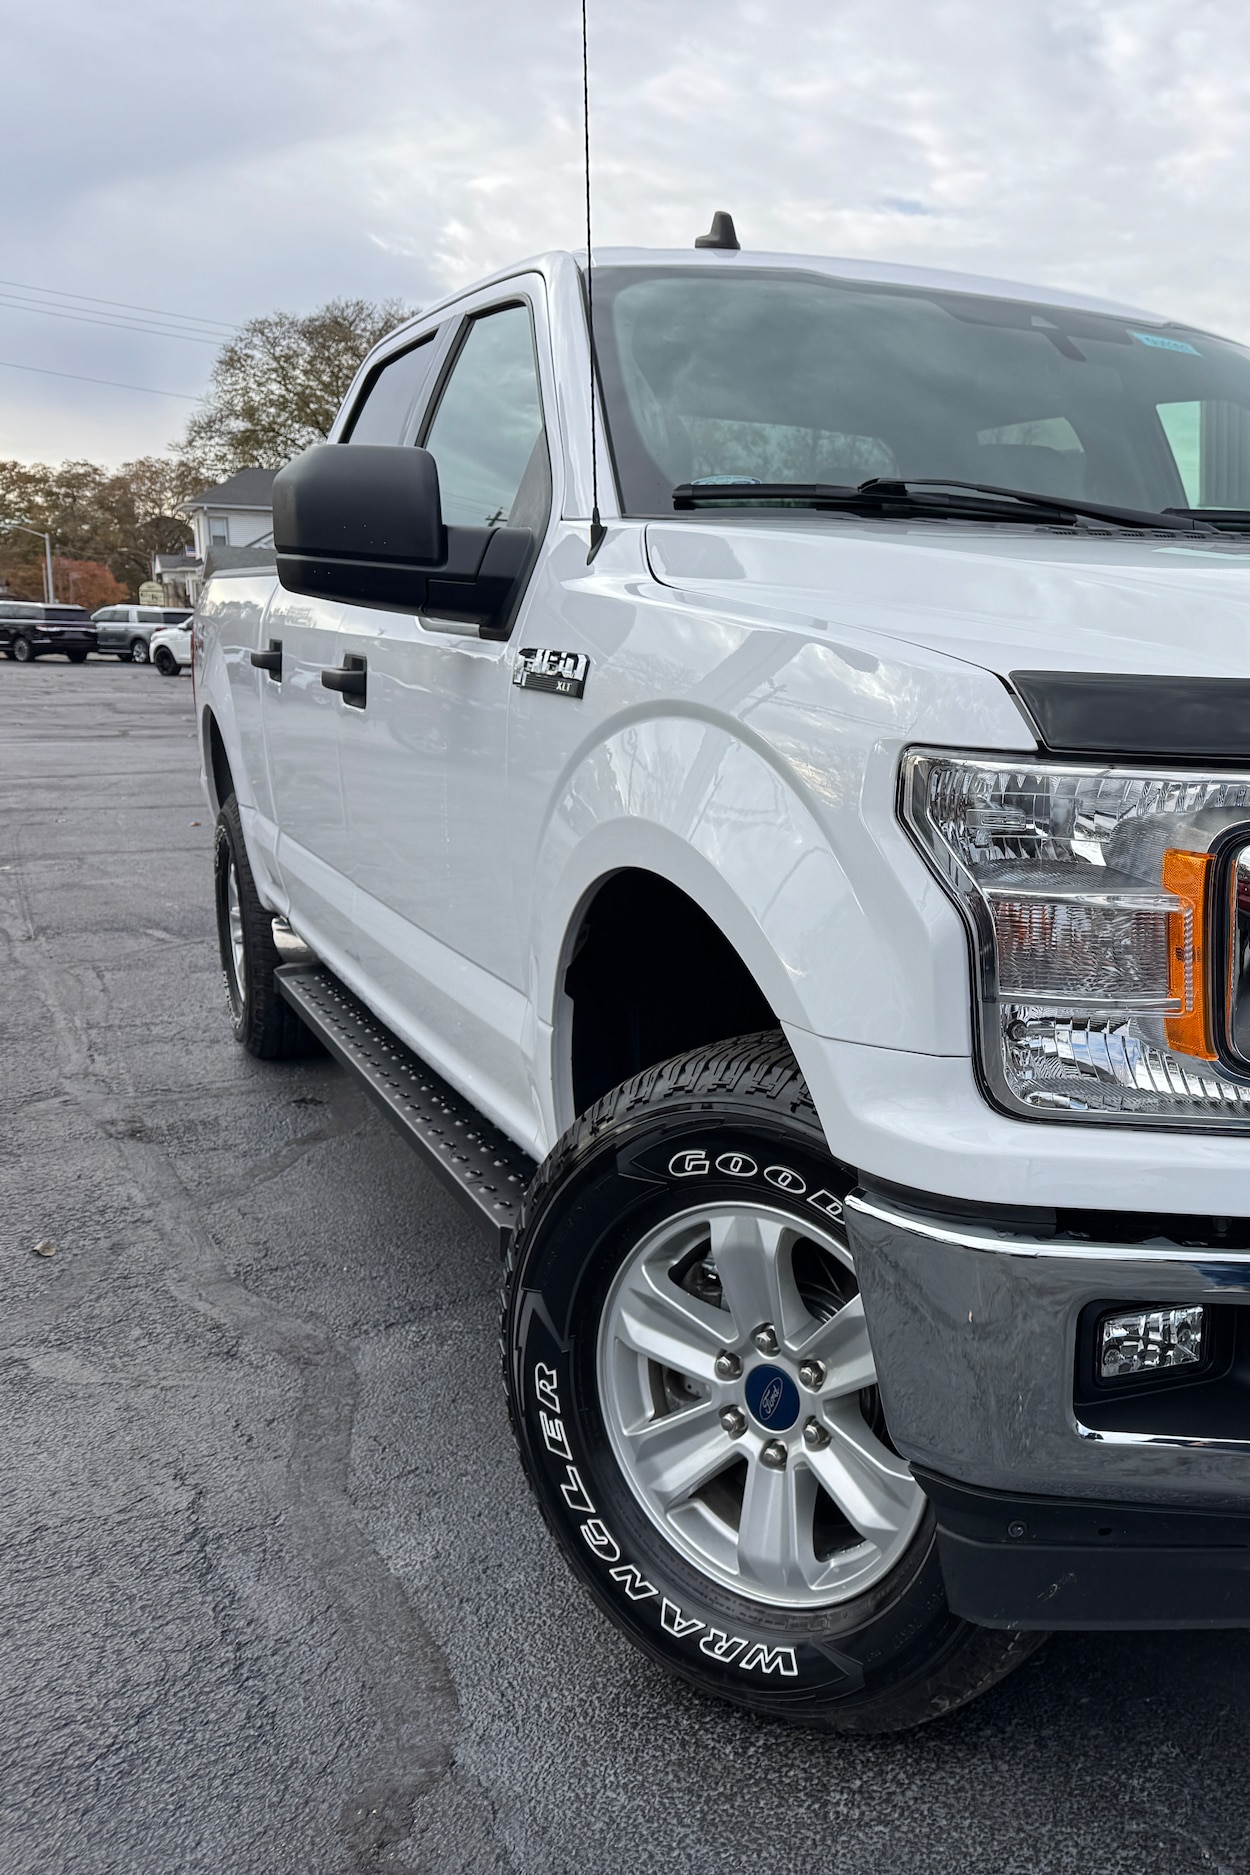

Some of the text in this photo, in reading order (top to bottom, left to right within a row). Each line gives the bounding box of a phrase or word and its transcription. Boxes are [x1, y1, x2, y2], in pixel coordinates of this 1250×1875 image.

[556, 681, 572, 692] XLT
[762, 1384, 779, 1414] Ford
[535, 1362, 798, 1676] WRANGLER
